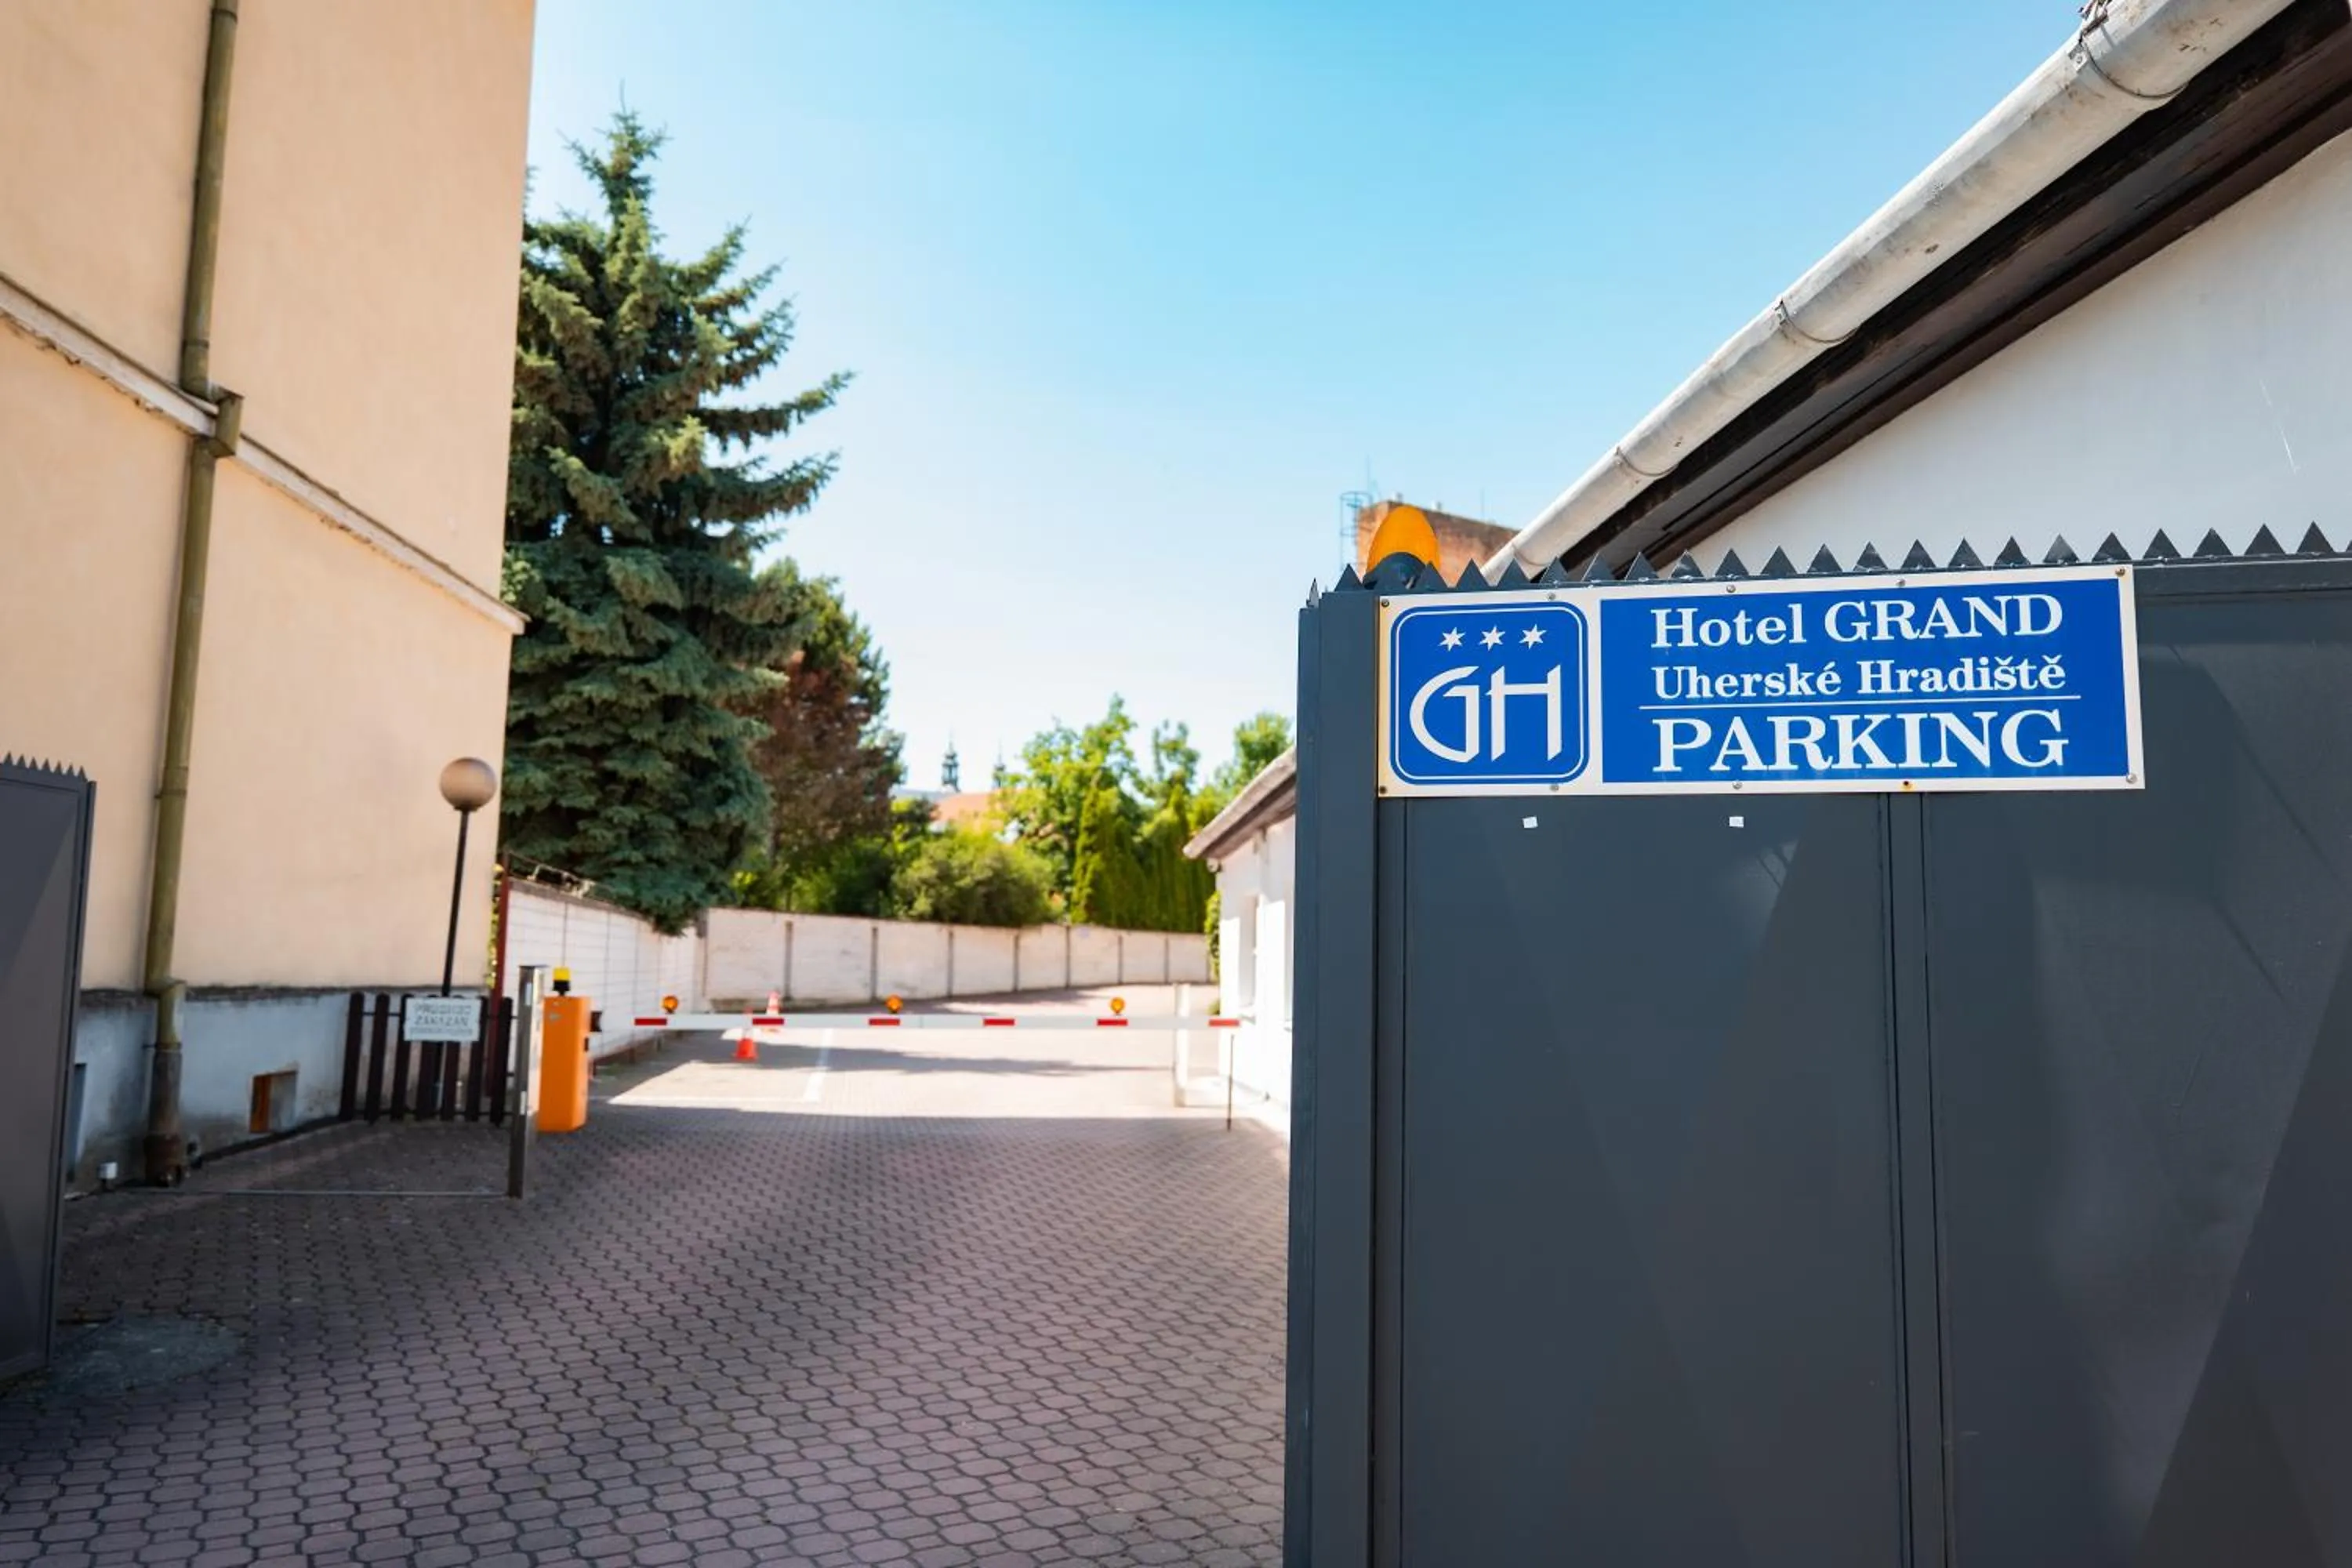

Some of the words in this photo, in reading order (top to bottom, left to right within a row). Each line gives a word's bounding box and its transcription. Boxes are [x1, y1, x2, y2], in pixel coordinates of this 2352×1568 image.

[1650, 603, 1807, 648] Hotel
[1824, 593, 2063, 642] GRAND
[1652, 661, 1842, 699] Uherské
[1856, 655, 2066, 694] Hradiště
[1409, 664, 1562, 763] GH
[1652, 709, 2069, 772] PARKING
